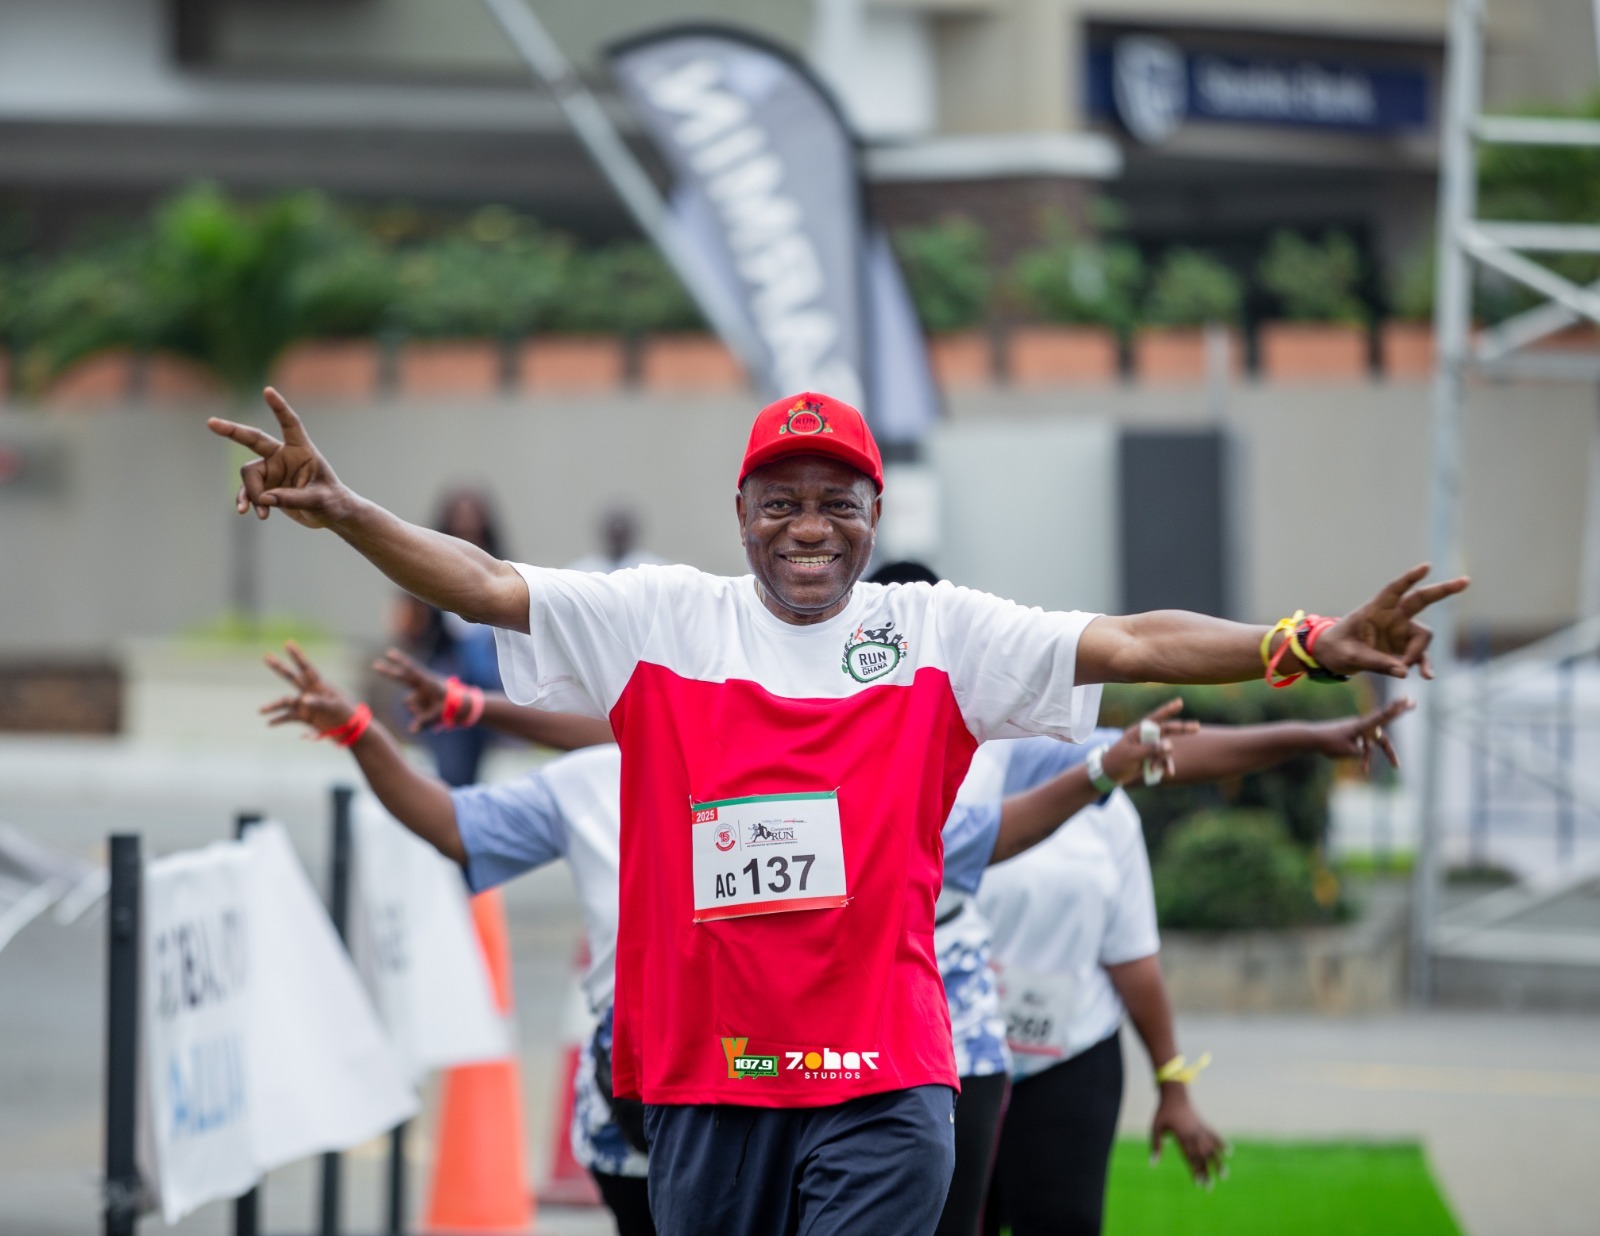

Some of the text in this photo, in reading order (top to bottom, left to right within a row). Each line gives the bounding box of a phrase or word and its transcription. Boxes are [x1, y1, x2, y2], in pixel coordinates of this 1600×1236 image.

[858, 651, 887, 666] RUN
[862, 662, 888, 676] GHANA
[696, 809, 715, 822] 2025
[771, 830, 795, 841] RUN
[715, 854, 816, 899] AC 137
